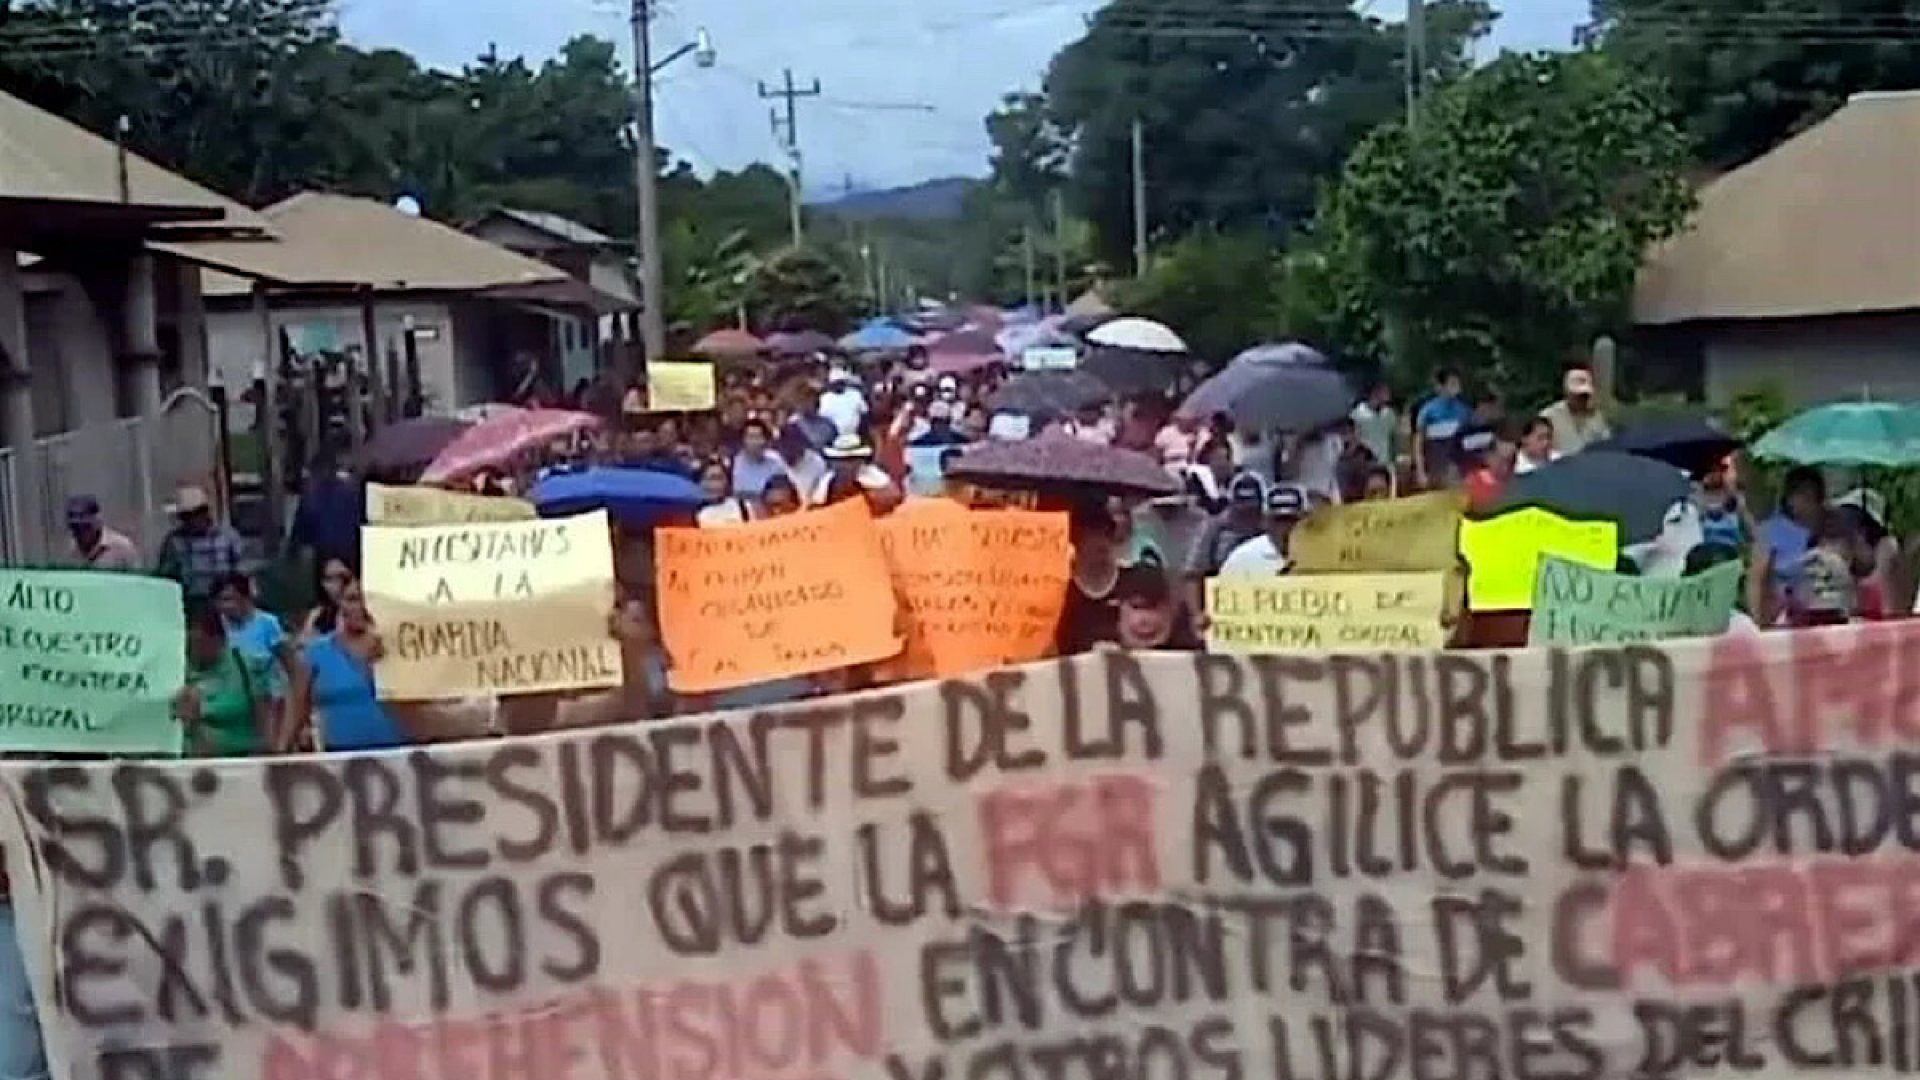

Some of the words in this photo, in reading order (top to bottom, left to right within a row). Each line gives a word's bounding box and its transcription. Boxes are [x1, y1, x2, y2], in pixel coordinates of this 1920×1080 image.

[398, 525, 571, 570] NECESITAMS
[7, 578, 75, 615] ALTO
[427, 577, 455, 604] A
[0, 626, 142, 657] ECUESTRO
[477, 643, 617, 688] NACIONAL
[0, 703, 105, 732] ROZAL
[23, 764, 231, 893] SR:
[262, 696, 914, 890] PRESIDENTE
[939, 671, 1046, 783] DE
[1060, 655, 1164, 761] LA
[1194, 646, 1675, 764] REPUBLICA
[62, 870, 600, 1030] EXIGIMOS
[647, 830, 838, 957] QUE
[859, 808, 965, 925] LA
[1193, 764, 1529, 888] AGILICE
[1562, 765, 1673, 873] LA
[1431, 886, 1533, 1001] DE
[1267, 1008, 1604, 1080] LIDERES
[1632, 996, 1766, 1079] DEL
[1773, 970, 1920, 1074] CRI
